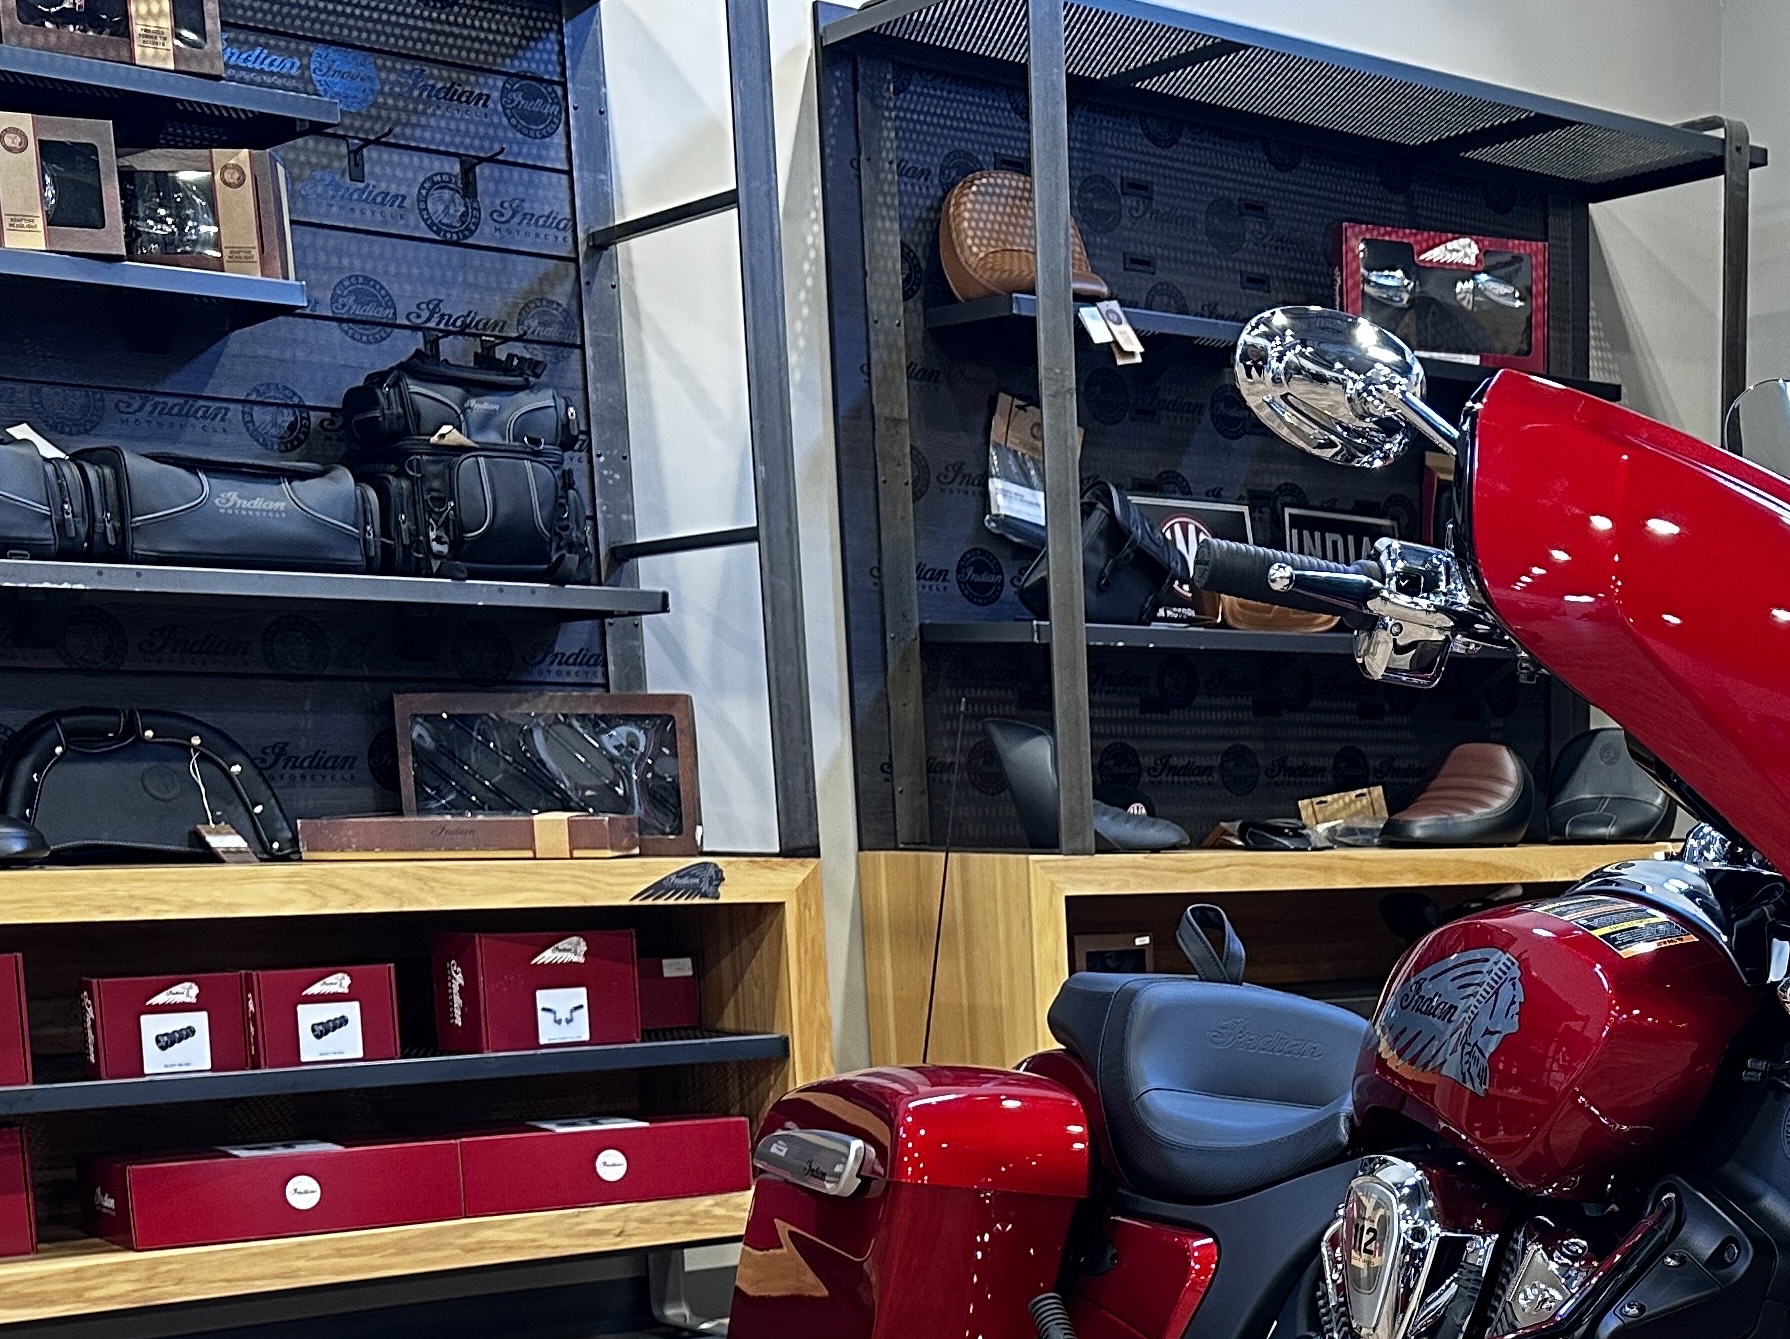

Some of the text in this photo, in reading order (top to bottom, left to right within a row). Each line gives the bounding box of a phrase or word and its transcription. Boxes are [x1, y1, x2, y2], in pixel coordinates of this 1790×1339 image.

[490, 198, 574, 232] India
[406, 298, 508, 334] Indian
[214, 491, 287, 512] Indian
[1291, 528, 1372, 566] INDIA
[522, 647, 605, 669] India
[253, 742, 357, 771] Indian
[1148, 754, 1214, 778] Indian
[1266, 755, 1328, 779] Indian
[266, 771, 357, 782] OTORCYCLE
[1400, 976, 1460, 1025] Indian
[1206, 1016, 1326, 1061] Indian
[1353, 1222, 1378, 1256] 112
